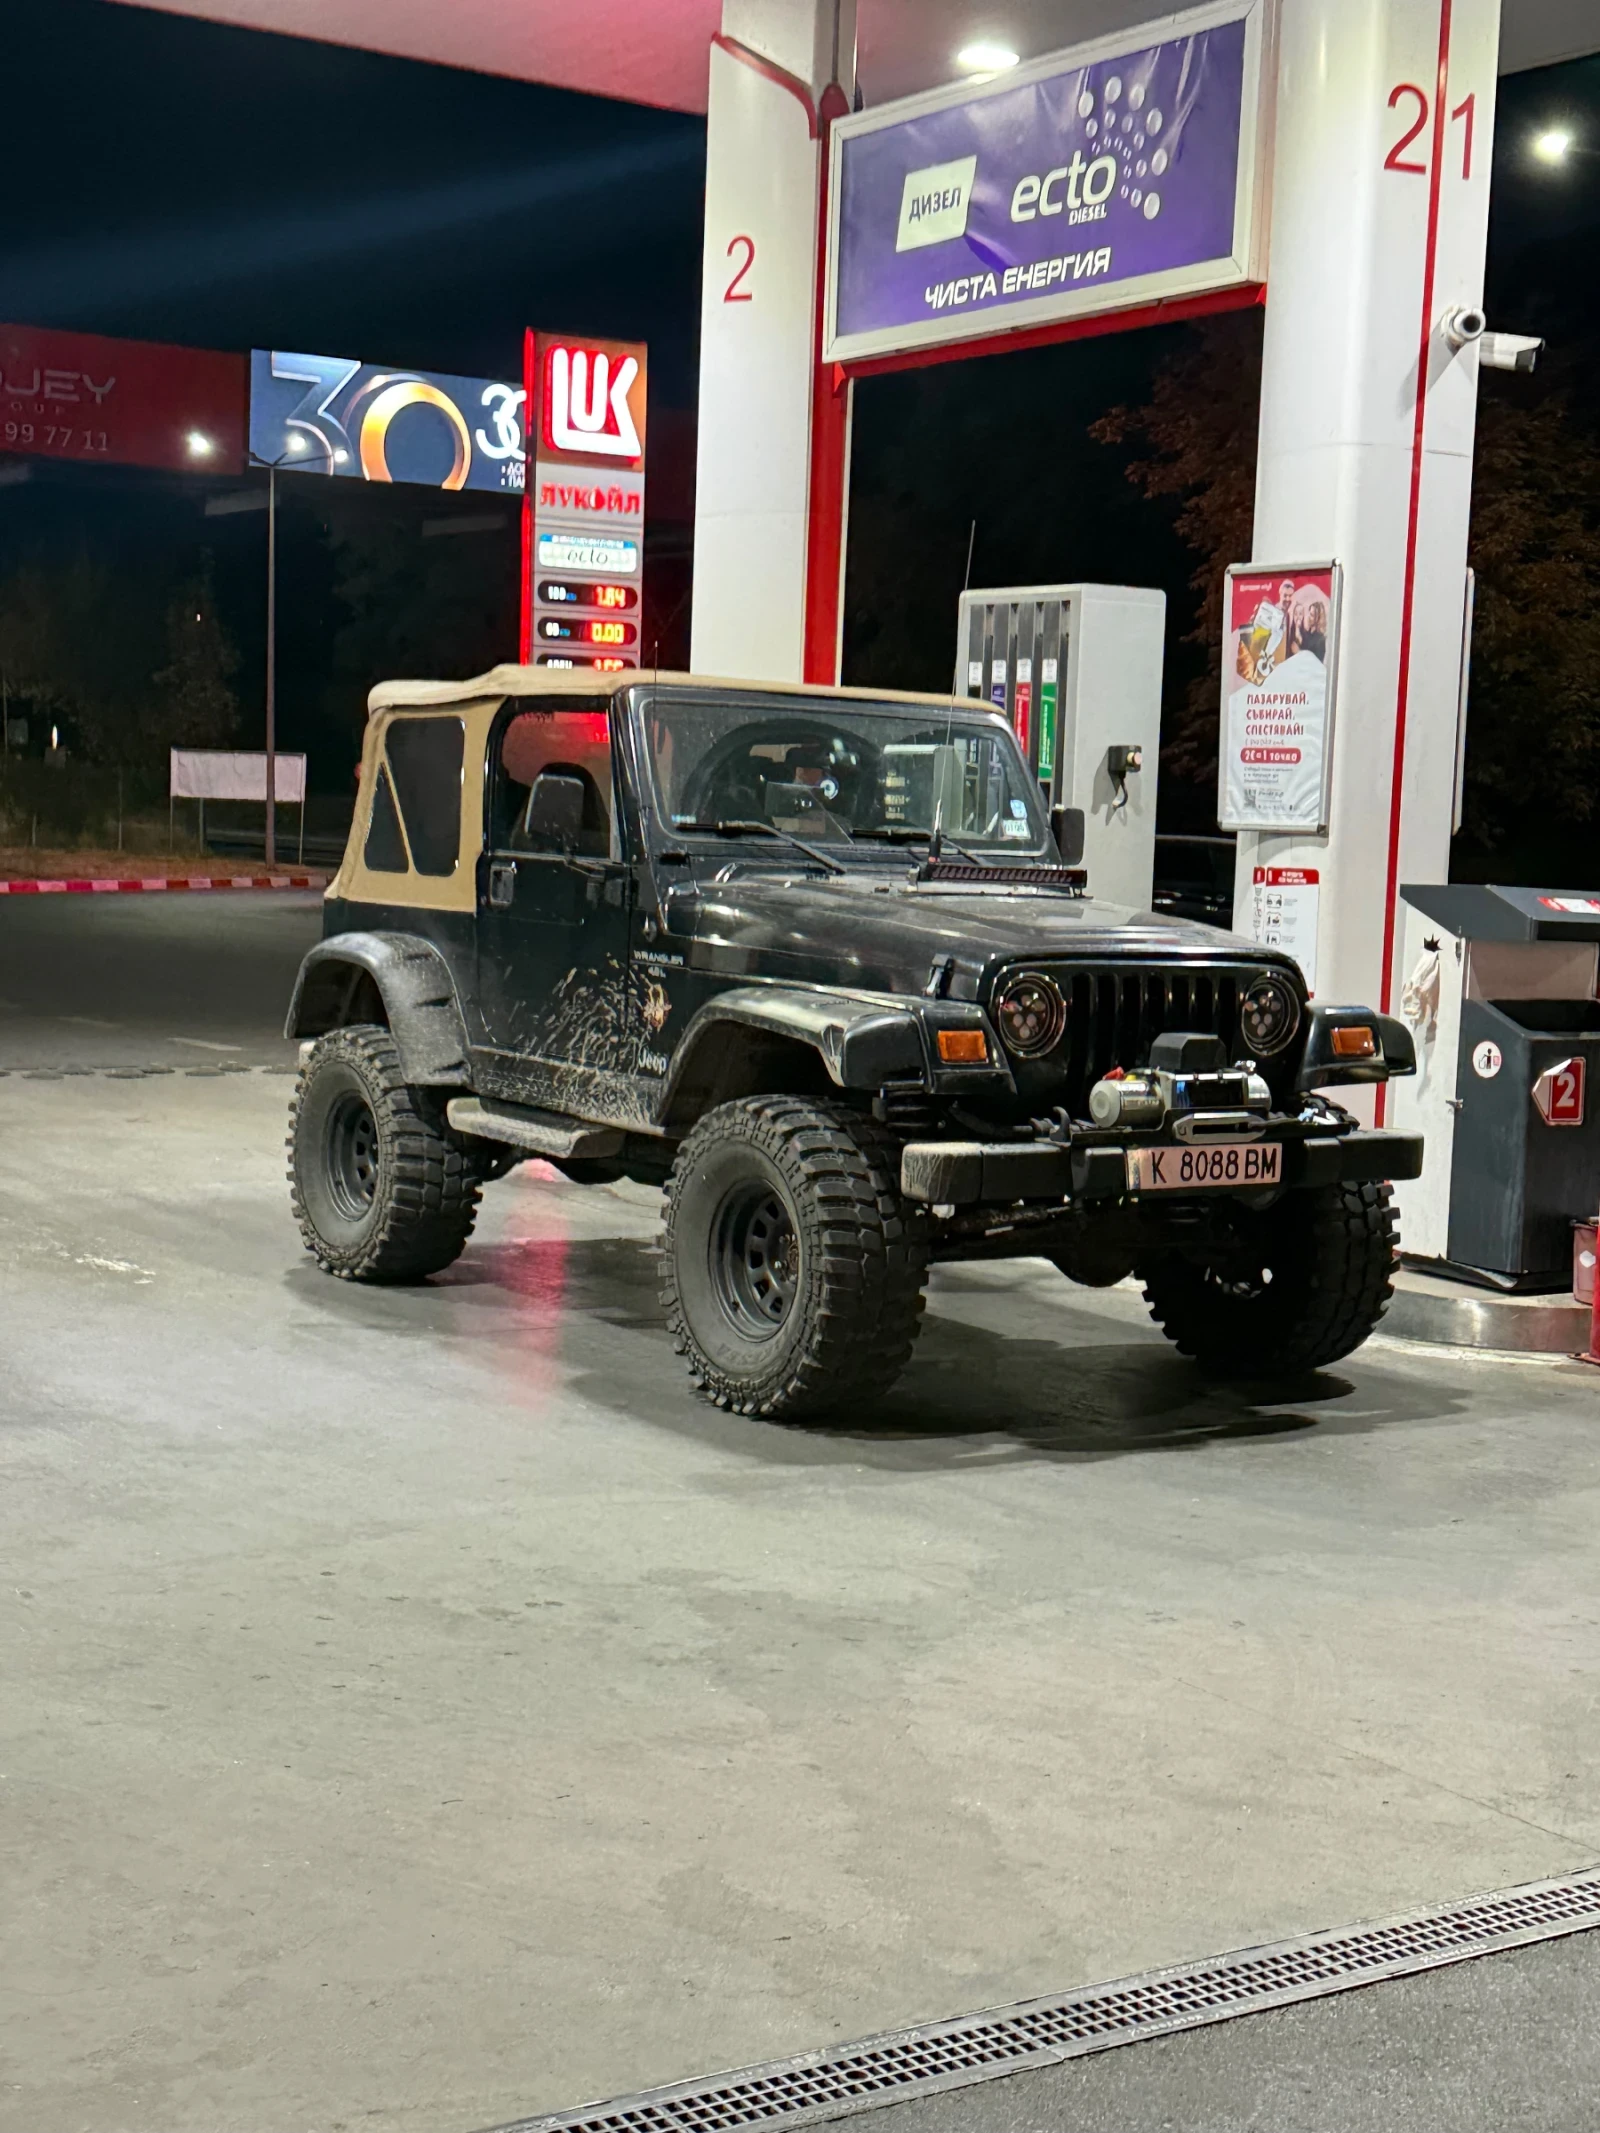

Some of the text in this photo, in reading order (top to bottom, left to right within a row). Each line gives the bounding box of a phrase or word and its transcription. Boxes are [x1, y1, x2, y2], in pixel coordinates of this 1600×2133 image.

[1384, 83, 1428, 175] 2
[1452, 93, 1476, 180] 1
[908, 186, 962, 223] ДИЗЕЛ
[1009, 150, 1118, 224] ecto
[1068, 203, 1108, 227] DIESEL
[723, 235, 756, 304] 2
[924, 246, 1113, 310] ЧИСТА ЕНЕРГИЯ
[0, 369, 116, 404] JEY
[633, 950, 684, 966] WRANGLER
[638, 1047, 667, 1075] Jeep
[1556, 1072, 1576, 1108] 2
[1151, 1147, 1277, 1184] K 8088 BM
